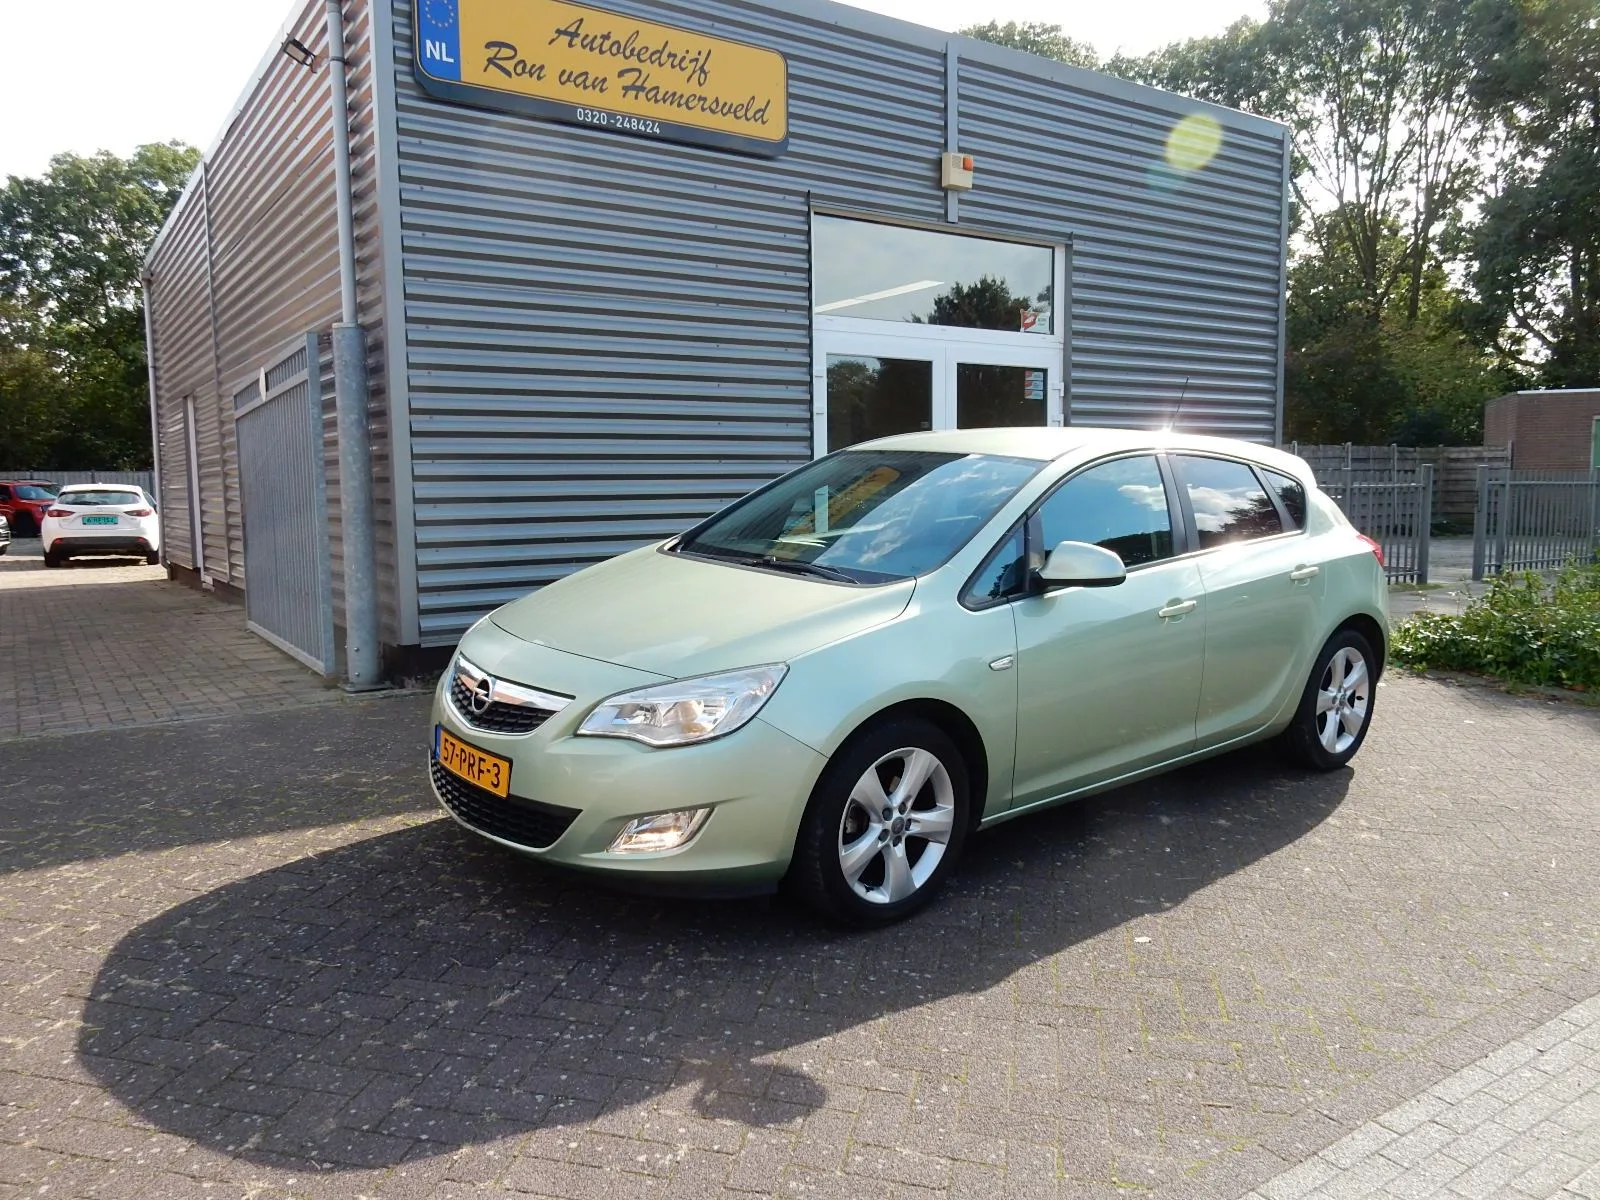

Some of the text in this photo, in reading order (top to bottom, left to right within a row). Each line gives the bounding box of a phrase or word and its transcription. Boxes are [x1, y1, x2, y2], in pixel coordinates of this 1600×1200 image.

[425, 39, 455, 63] NL
[548, 17, 712, 87] Autobedrijf
[483, 40, 770, 125] Ron van Hamersveld
[577, 108, 661, 134] 0320-248424
[442, 737, 501, 789] 57-PRF-3
